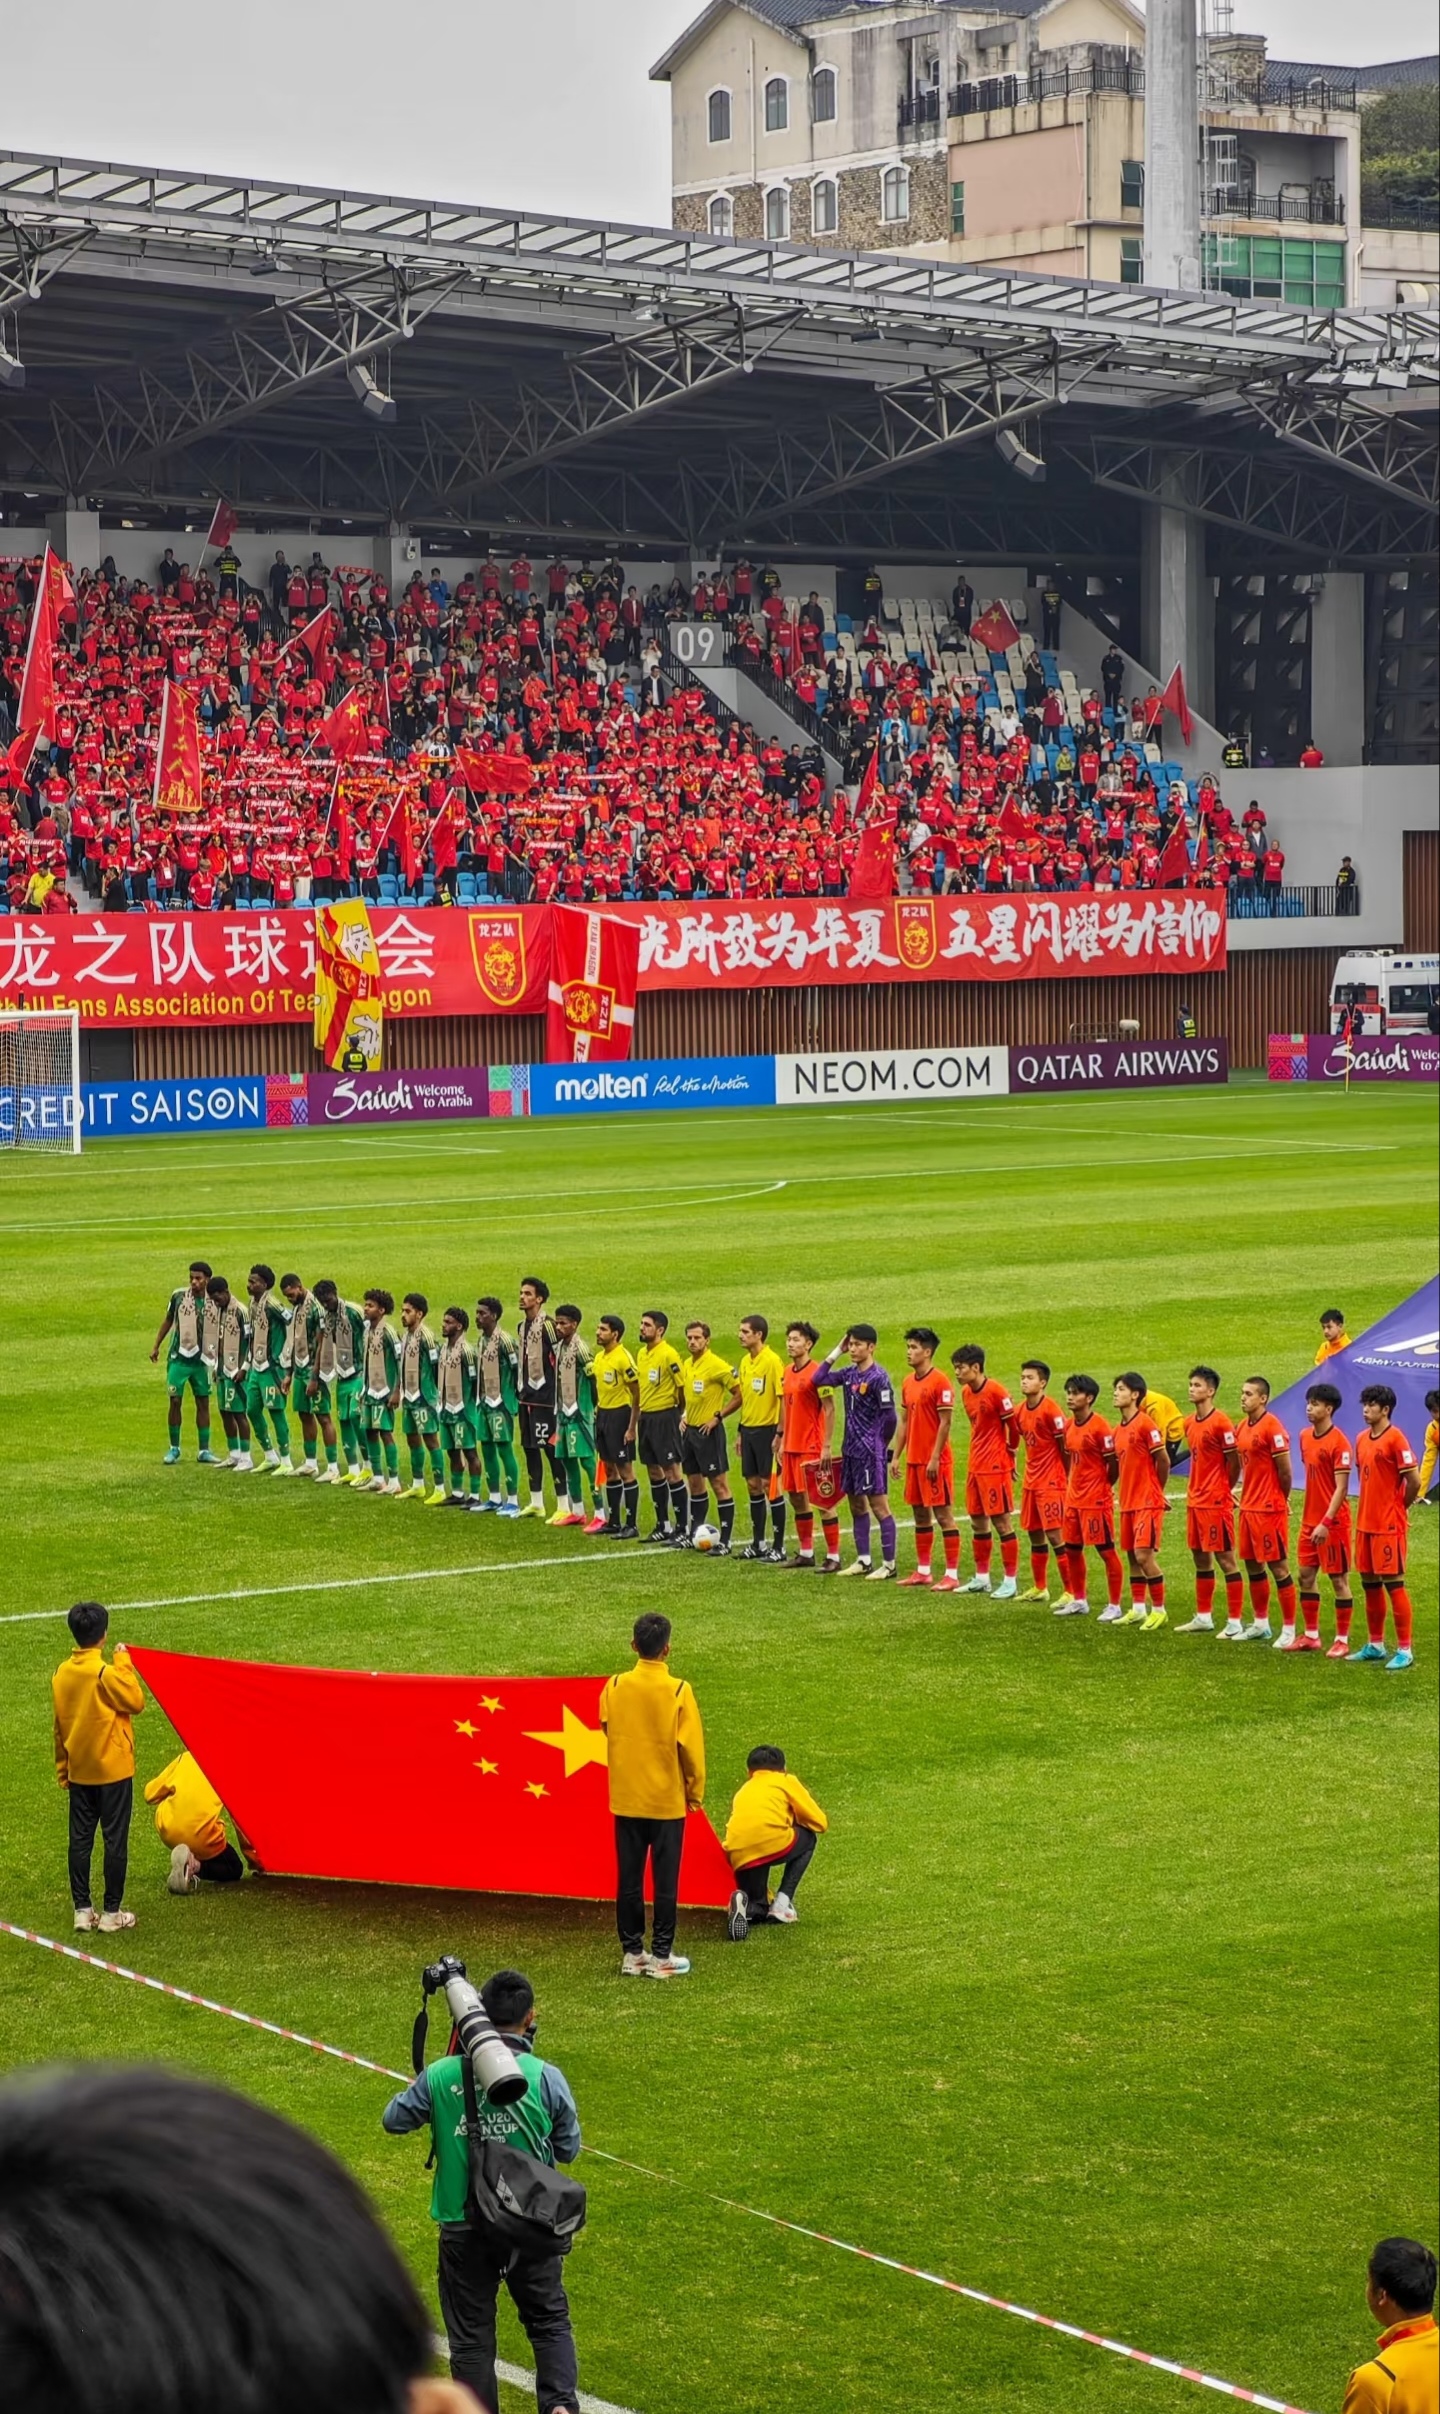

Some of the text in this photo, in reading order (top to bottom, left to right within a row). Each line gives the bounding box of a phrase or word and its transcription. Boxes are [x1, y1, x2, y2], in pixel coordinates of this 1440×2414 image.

[678, 627, 714, 662] 09
[478, 923, 515, 937] 龙之队
[939, 899, 1221, 965] 五星闪耀为信仰
[114, 991, 244, 1017] Association
[250, 989, 275, 1012] Of
[280, 989, 316, 1011] Tea
[1017, 1048, 1219, 1084] QATAR AIRWAYS
[1323, 1040, 1410, 1077] Saudi
[1421, 1061, 1431, 1071] to
[795, 1055, 991, 1095] NEOM.COM
[413, 1084, 465, 1097] Welcome
[555, 1073, 648, 1101] molten
[680, 1077, 700, 1093] the
[324, 1077, 414, 1120] Saudi
[423, 1095, 473, 1108] to Arabia
[0, 1087, 260, 1130] CREDIT SAISON
[224, 1386, 236, 1401] 13
[265, 1386, 276, 1400] 19
[493, 1416, 503, 1430] 12
[535, 1422, 549, 1438] 22
[570, 1431, 577, 1445] 5
[865, 1469, 870, 1485] 1
[1043, 1501, 1060, 1519] 23
[1088, 1518, 1100, 1535] 10
[1209, 1525, 1218, 1540] 8
[1263, 1534, 1272, 1550] 6
[1327, 1544, 1337, 1561] 11
[1383, 1545, 1393, 1561] 9
[487, 2112, 511, 2124] U20
[454, 2123, 519, 2137] ASN CUP
